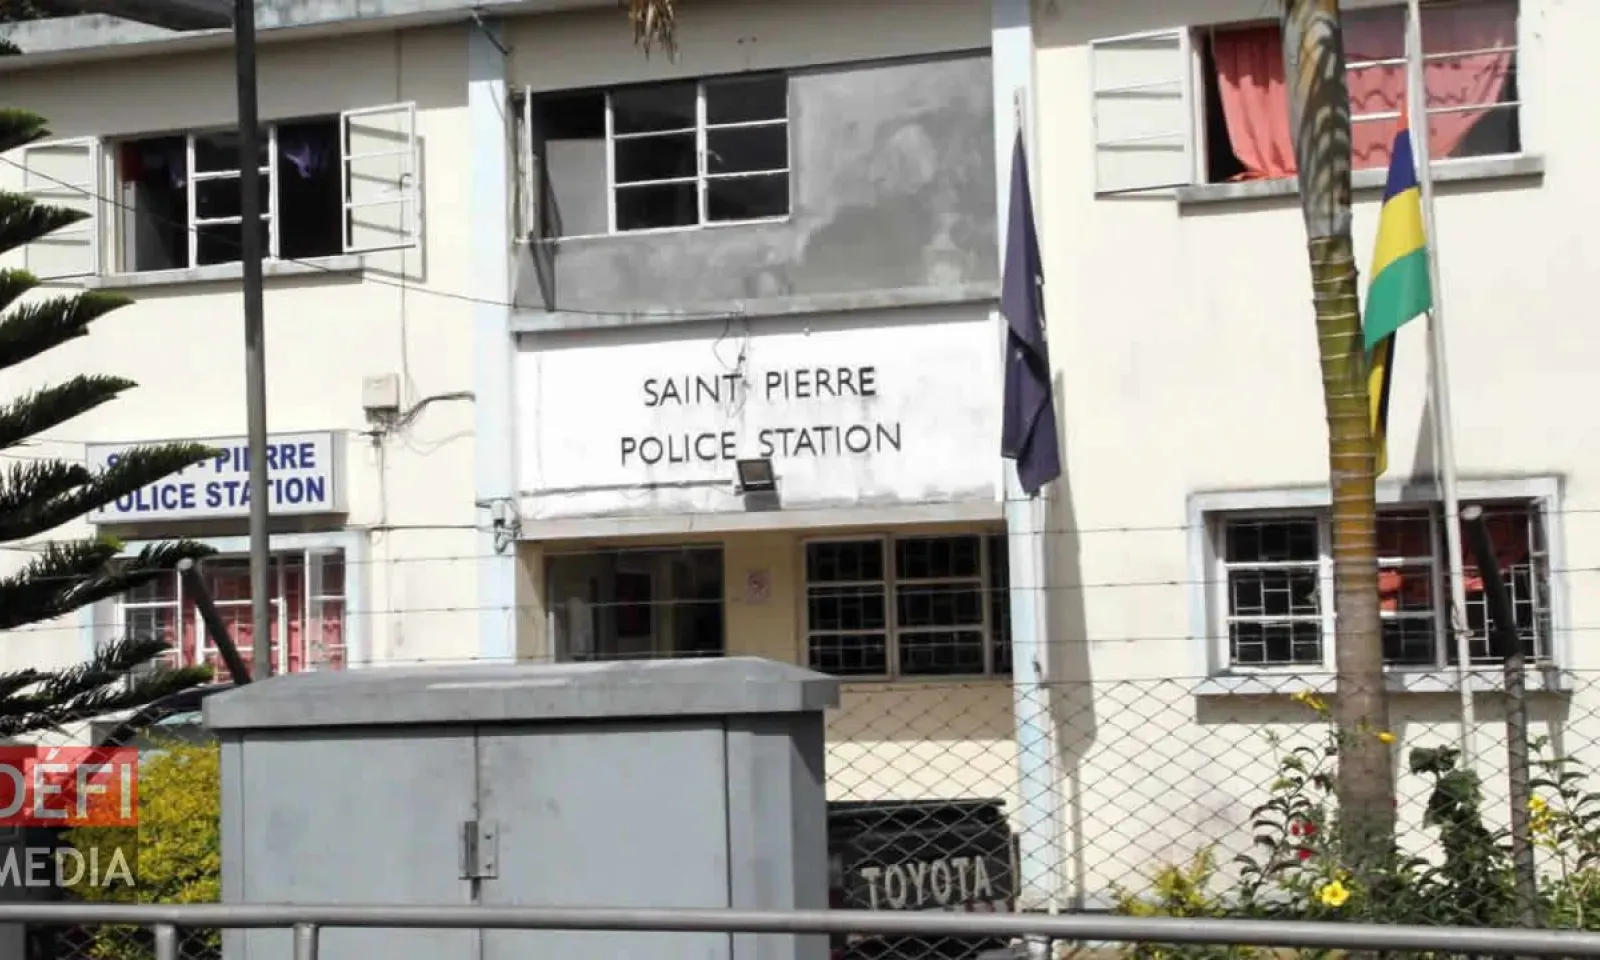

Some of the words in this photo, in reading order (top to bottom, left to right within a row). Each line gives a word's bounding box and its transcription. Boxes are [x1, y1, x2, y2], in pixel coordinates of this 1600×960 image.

[643, 373, 743, 407] SAINT
[765, 366, 877, 400] PIERRE
[621, 431, 737, 466] POLICE
[758, 421, 902, 459] STATION
[98, 483, 196, 513] OLICE
[205, 475, 326, 508] STAION
[861, 854, 993, 909] TOYOTA
